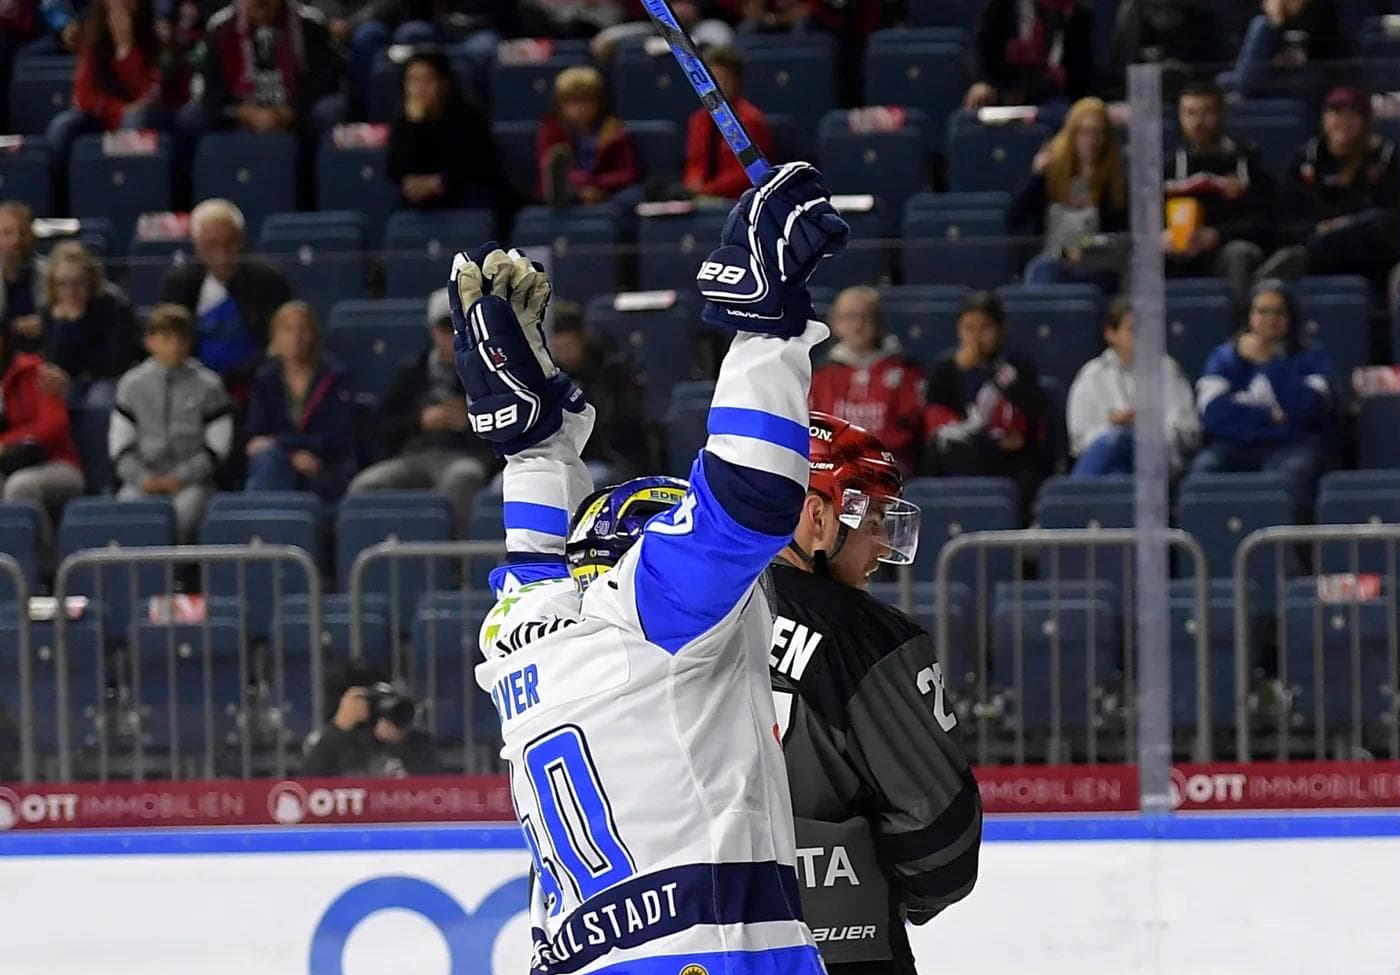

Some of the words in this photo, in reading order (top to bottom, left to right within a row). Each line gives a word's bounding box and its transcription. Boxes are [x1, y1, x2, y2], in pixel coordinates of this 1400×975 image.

[769, 616, 823, 681] EN
[1186, 773, 1247, 802] OTT
[20, 793, 78, 822] OTT
[309, 788, 367, 817] OTT
[811, 925, 876, 943] AUER
